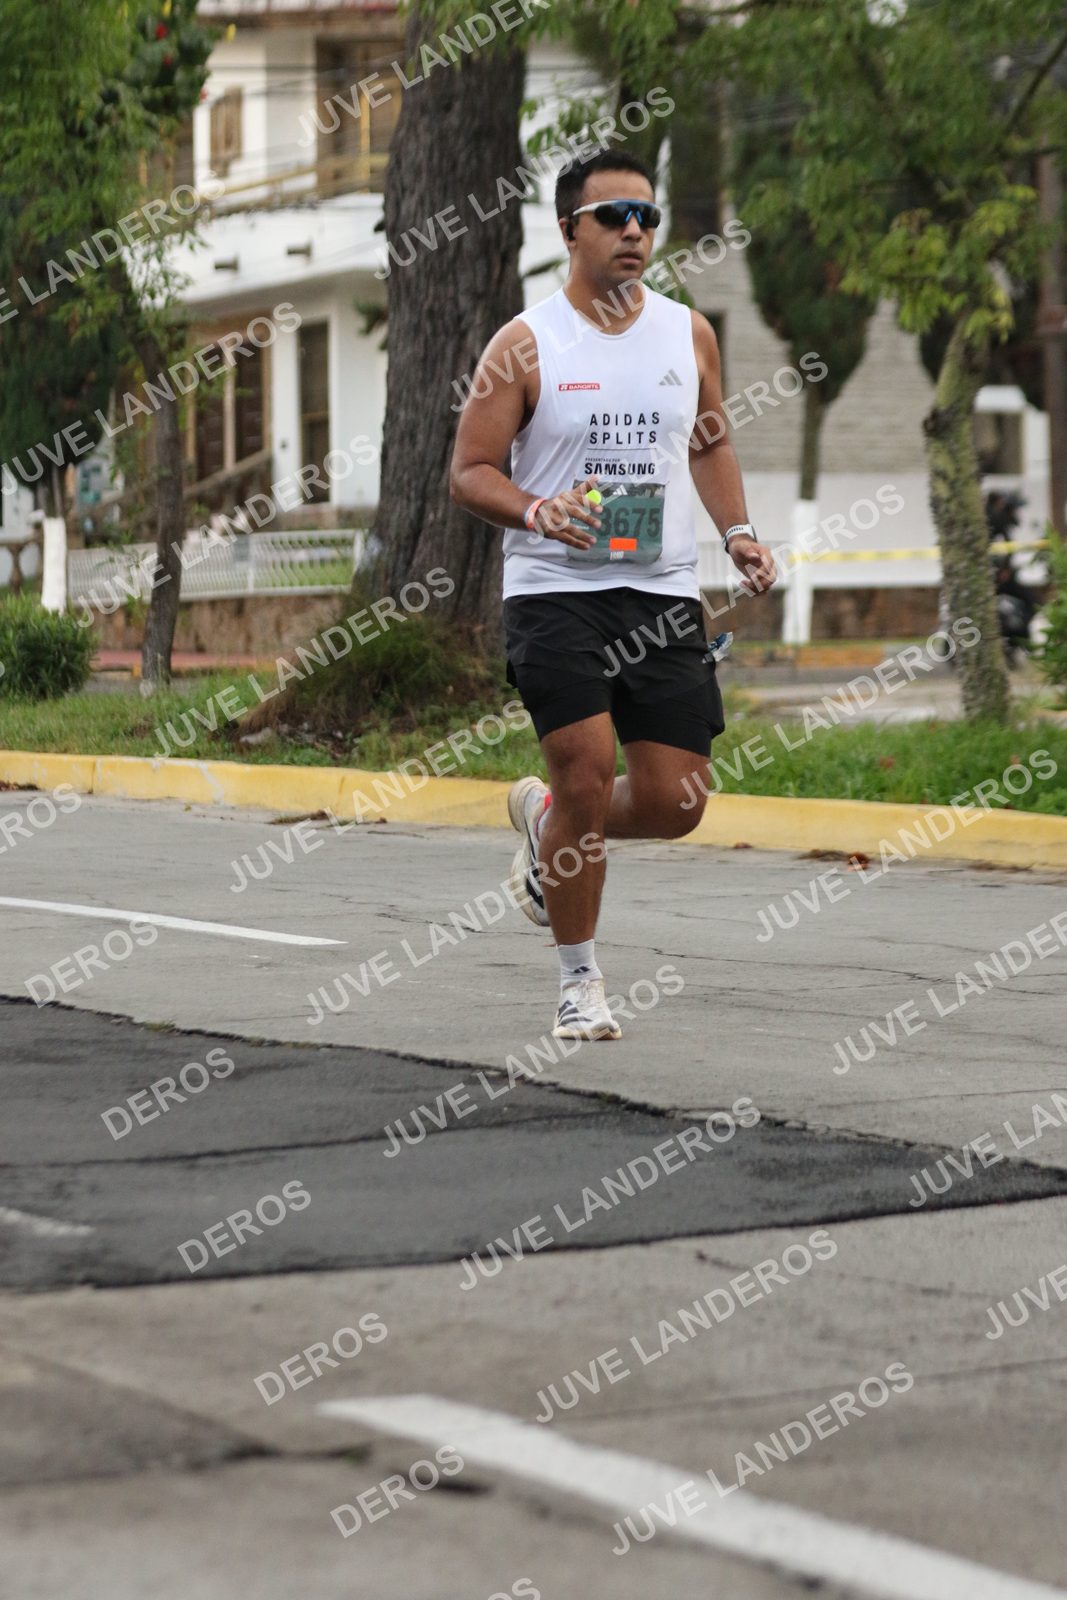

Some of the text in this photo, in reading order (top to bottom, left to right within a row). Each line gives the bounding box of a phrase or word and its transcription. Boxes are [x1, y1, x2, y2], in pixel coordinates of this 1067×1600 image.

[590, 412, 660, 426] ADIDAS
[590, 431, 657, 445] SPLITS
[584, 462, 656, 476] SAMSUNG
